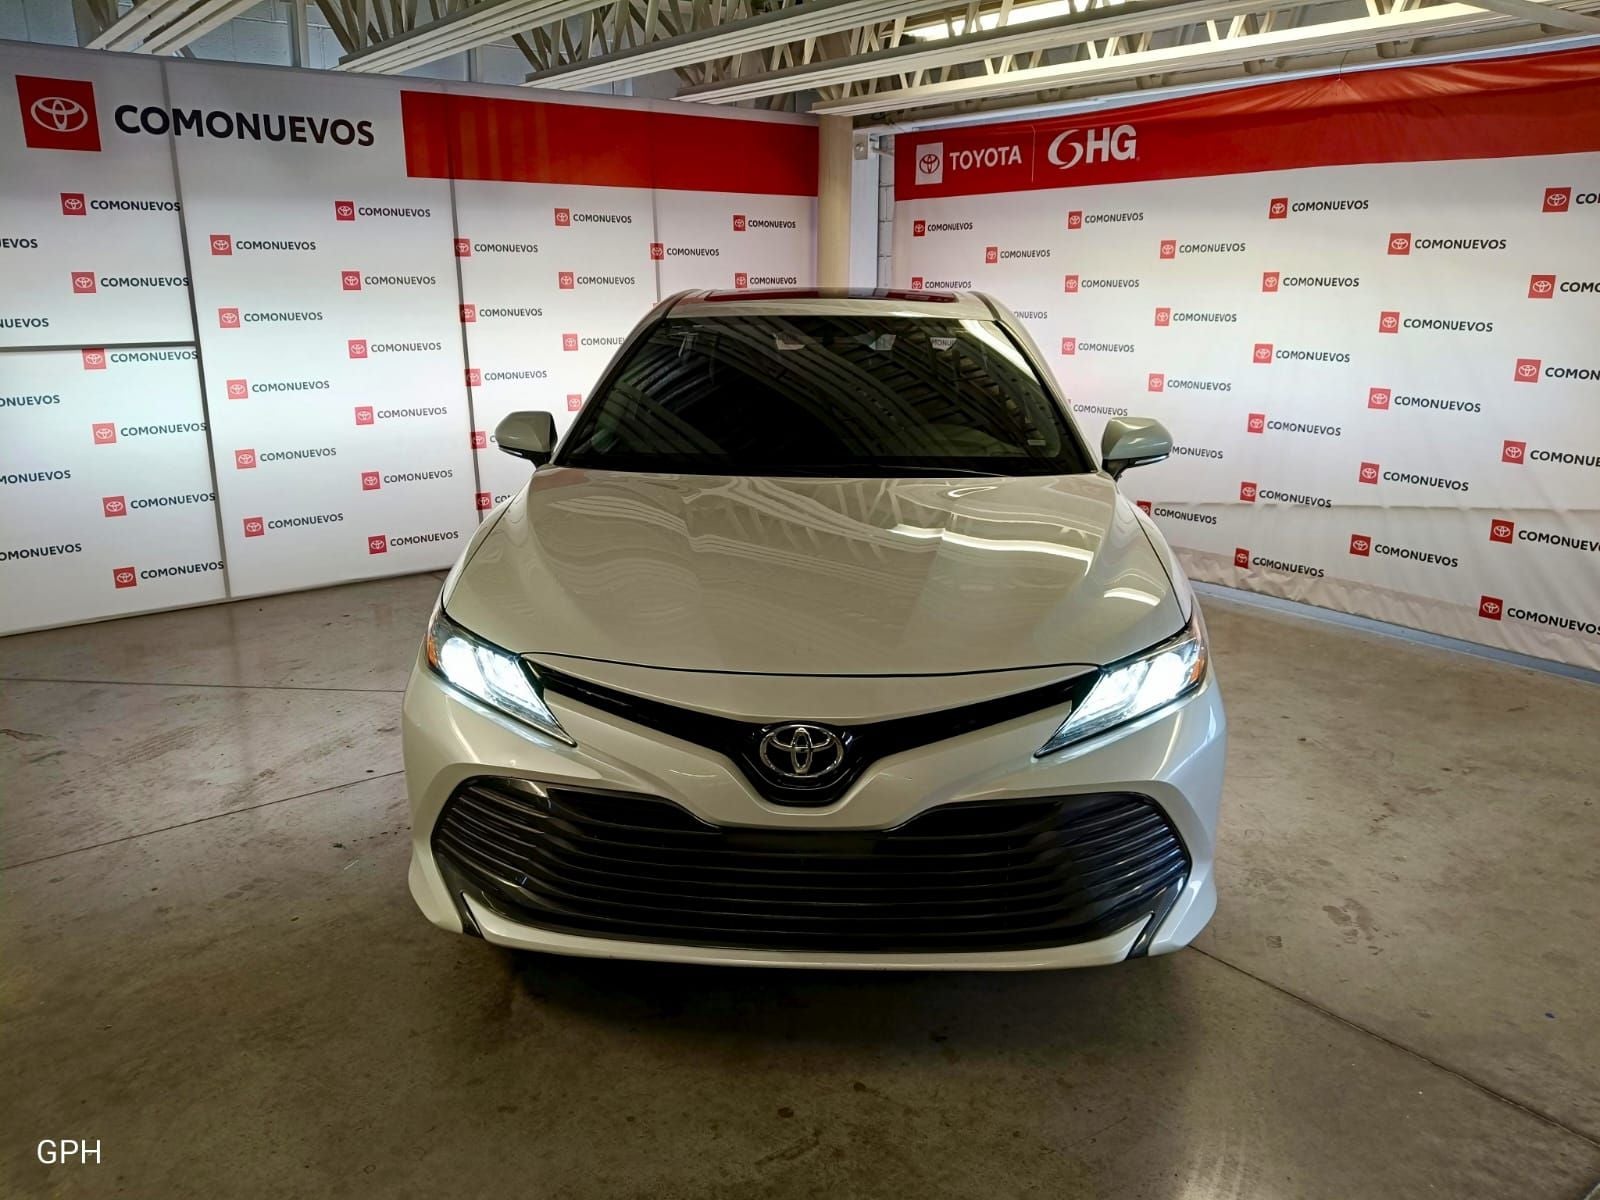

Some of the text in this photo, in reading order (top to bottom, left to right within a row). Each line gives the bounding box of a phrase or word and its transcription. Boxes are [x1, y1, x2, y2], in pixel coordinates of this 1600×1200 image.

[114, 103, 375, 147] COMONUEVOS
[949, 145, 1022, 171] TOYOTA
[90, 199, 181, 212] COMONUEVOS
[1291, 199, 1369, 213] COMONUEVOS
[358, 207, 431, 218] COMONUEVOS
[572, 213, 632, 224] COMONUEVOS
[1084, 212, 1144, 224] COMONUEVOS
[747, 219, 797, 229] COMONUEVOS
[927, 222, 973, 232] COMONUEVOS
[235, 240, 317, 251] COMONUEVOS
[473, 243, 539, 253] COMONUEVOS
[1178, 242, 1246, 254] COMONUEVOS
[1414, 239, 1507, 250] COMONUEVOS
[666, 247, 720, 257] COMONUEVOS
[999, 249, 1051, 259] COMONUEVOS
[100, 276, 190, 289] COMONUEVOS
[364, 276, 436, 285] COMONUEVOS
[576, 275, 636, 287] COMONUEVOS
[749, 276, 797, 286] COMONUEVOS
[924, 280, 972, 289] COMONUEVOS
[1080, 279, 1140, 288] COMONUEVOS
[1282, 277, 1360, 288] COMONUEVOS
[243, 311, 323, 323] COMONUEVOS
[479, 307, 543, 318] COMONUEVOS
[1172, 312, 1237, 323] COMONUEVOS
[0, 317, 50, 329] UEVOS
[1403, 318, 1494, 333] COMONUEVOS
[370, 342, 442, 353] COMONUEVOS
[581, 336, 624, 346] COMONUE
[1077, 342, 1135, 353] COMONUEVOS
[110, 351, 199, 364] COMONUEVOS
[1275, 349, 1351, 363] COMONUEVOS
[484, 370, 548, 382] COMONUEVOS
[251, 380, 330, 393] COMONUEVOS
[1167, 379, 1232, 392] COMONUEVOS
[1074, 403, 1129, 418] COMONUEVOS
[1394, 395, 1481, 413] COMONUEVOS
[377, 406, 448, 419] COMONUEVOS
[120, 422, 207, 438] COMONUEVOS
[1266, 420, 1342, 437] COMONUEVOS
[259, 447, 337, 462] COMONUEVOS
[1170, 446, 1224, 460] MONUEVOS
[383, 469, 453, 484] COMONUEVOS
[1383, 471, 1469, 492] COMONUEVOS
[130, 492, 217, 509] COMONUEVOS
[1259, 488, 1332, 509] COMONUEVOS
[267, 512, 344, 530] COMONUEVOS
[1153, 507, 1217, 525] COMONUEVOS
[389, 530, 459, 547] COMONUEVOS
[1518, 530, 1600, 552] COMONUEV
[1374, 543, 1459, 568] COMONUEVOS
[140, 560, 225, 580] COMONUEVOS
[1252, 556, 1326, 579] COMONUEVOS
